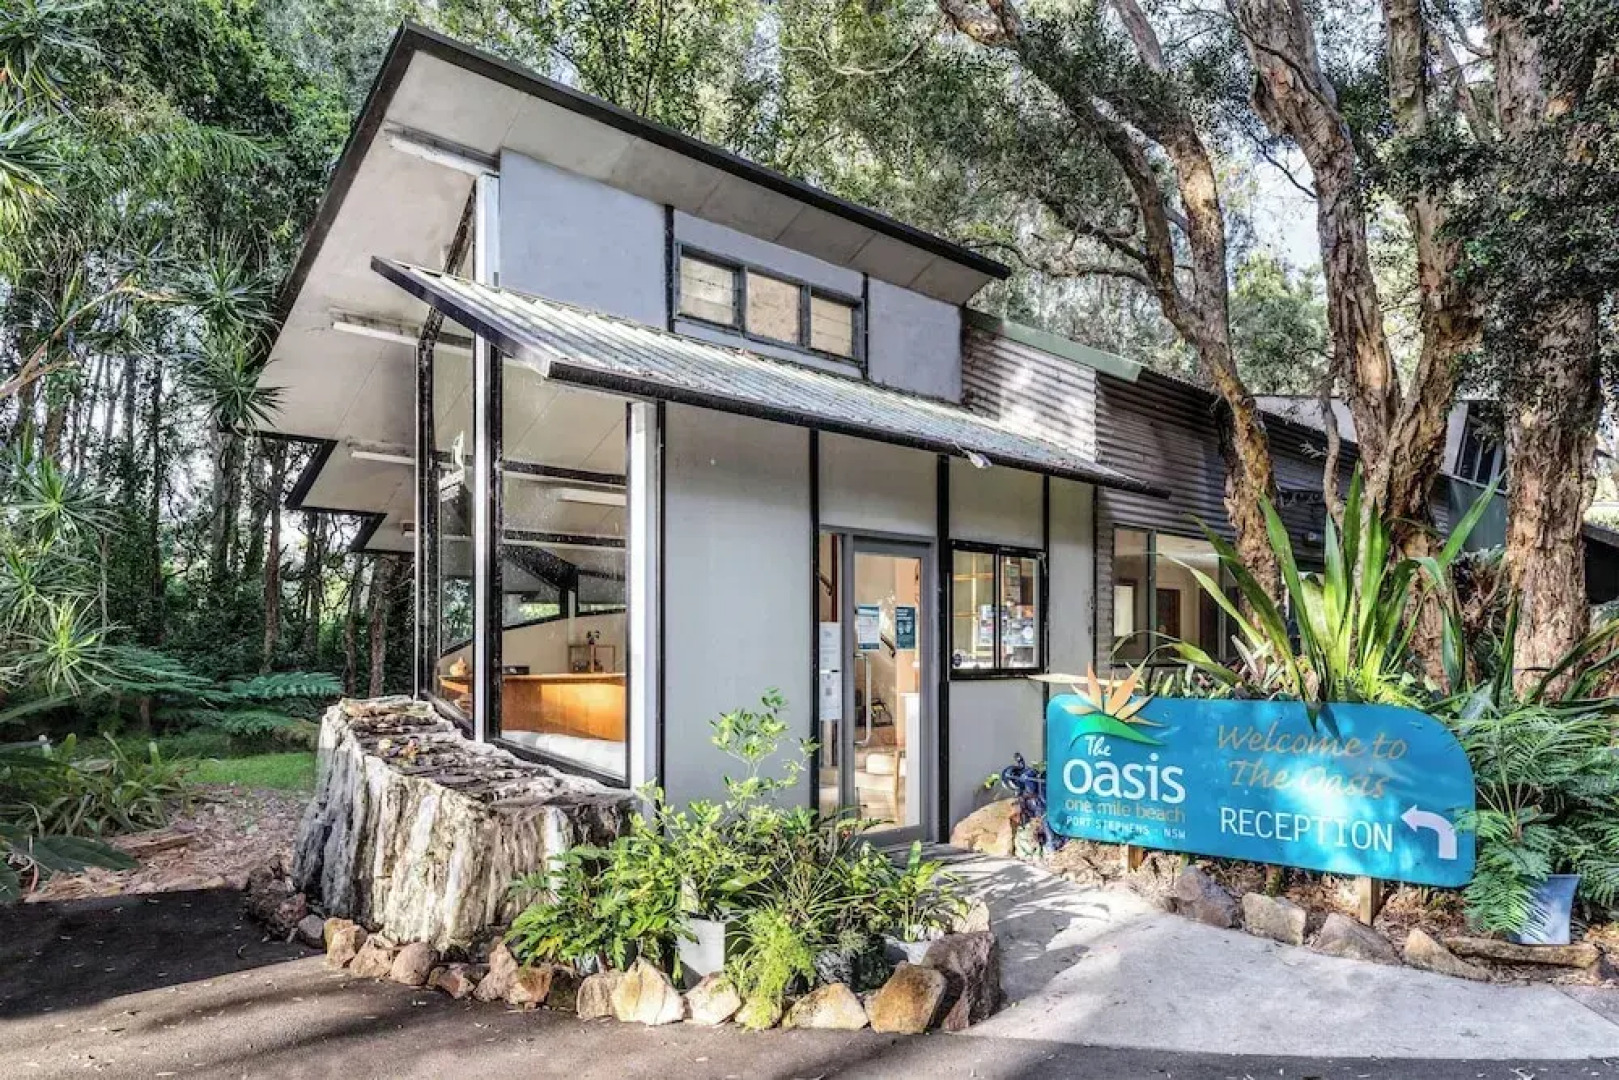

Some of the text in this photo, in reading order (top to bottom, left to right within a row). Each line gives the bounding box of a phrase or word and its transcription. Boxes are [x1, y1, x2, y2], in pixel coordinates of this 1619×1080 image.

[1085, 735, 1111, 756] The
[1218, 721, 1407, 760] Welcome to
[1063, 752, 1186, 804] oasis
[1229, 758, 1388, 799] The Oasis
[1064, 799, 1186, 823] one mile beach
[1066, 816, 1186, 839] PORT STEPHENS NSW
[1220, 807, 1393, 852] RECEPTION
